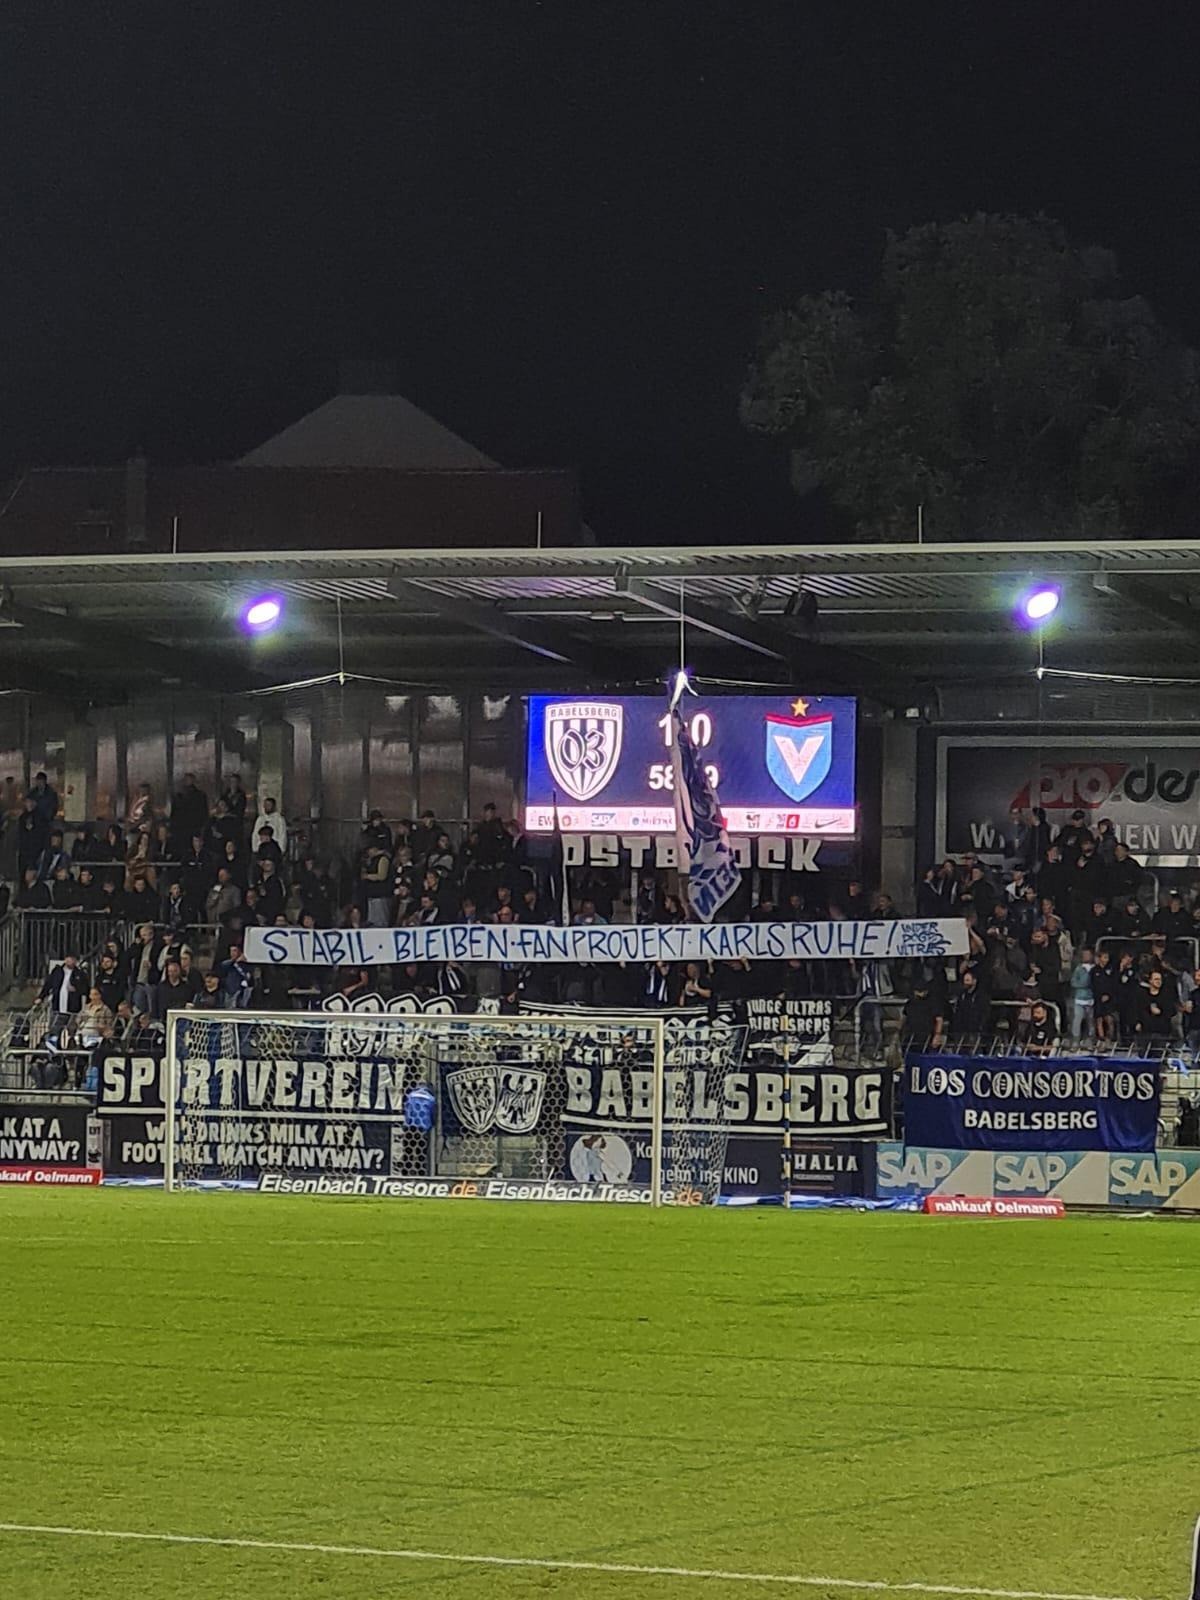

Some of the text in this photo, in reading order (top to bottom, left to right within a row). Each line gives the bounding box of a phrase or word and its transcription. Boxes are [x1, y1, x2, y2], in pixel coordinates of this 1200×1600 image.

[550, 707, 617, 718] BABELSBERG
[659, 713, 712, 747] 10
[558, 728, 607, 772] 03
[561, 834, 822, 872] OSTBOCK
[263, 930, 374, 965] STABIL
[393, 926, 508, 960] BLEIBEN
[786, 1000, 832, 1015] ULTRAS
[103, 1056, 406, 1110] SPORTVEREIN
[565, 1066, 882, 1123] BABELSBERG
[911, 1066, 1154, 1101] LOS CONSORTOS
[21, 1117, 45, 1138] AT
[48, 1118, 62, 1139] A
[964, 1109, 1098, 1130] BABELSBERG
[197, 1121, 264, 1144] DRINKS
[269, 1123, 319, 1146] MILK
[322, 1125, 348, 1147] AT
[350, 1126, 365, 1148] A
[216, 1144, 284, 1167] MATCH
[286, 1146, 385, 1170] ANYWAY?
[878, 1151, 950, 1188] SAP
[34, 1171, 94, 1184] Oelmann
[260, 1174, 367, 1195] Eisenbach
[724, 1167, 759, 1185] KINO
[994, 1154, 1067, 1193] SAP
[1110, 1158, 1187, 1197] SAP
[486, 1181, 594, 1201] Eisenbach
[935, 1199, 1058, 1215] nahkauf Oelmann
